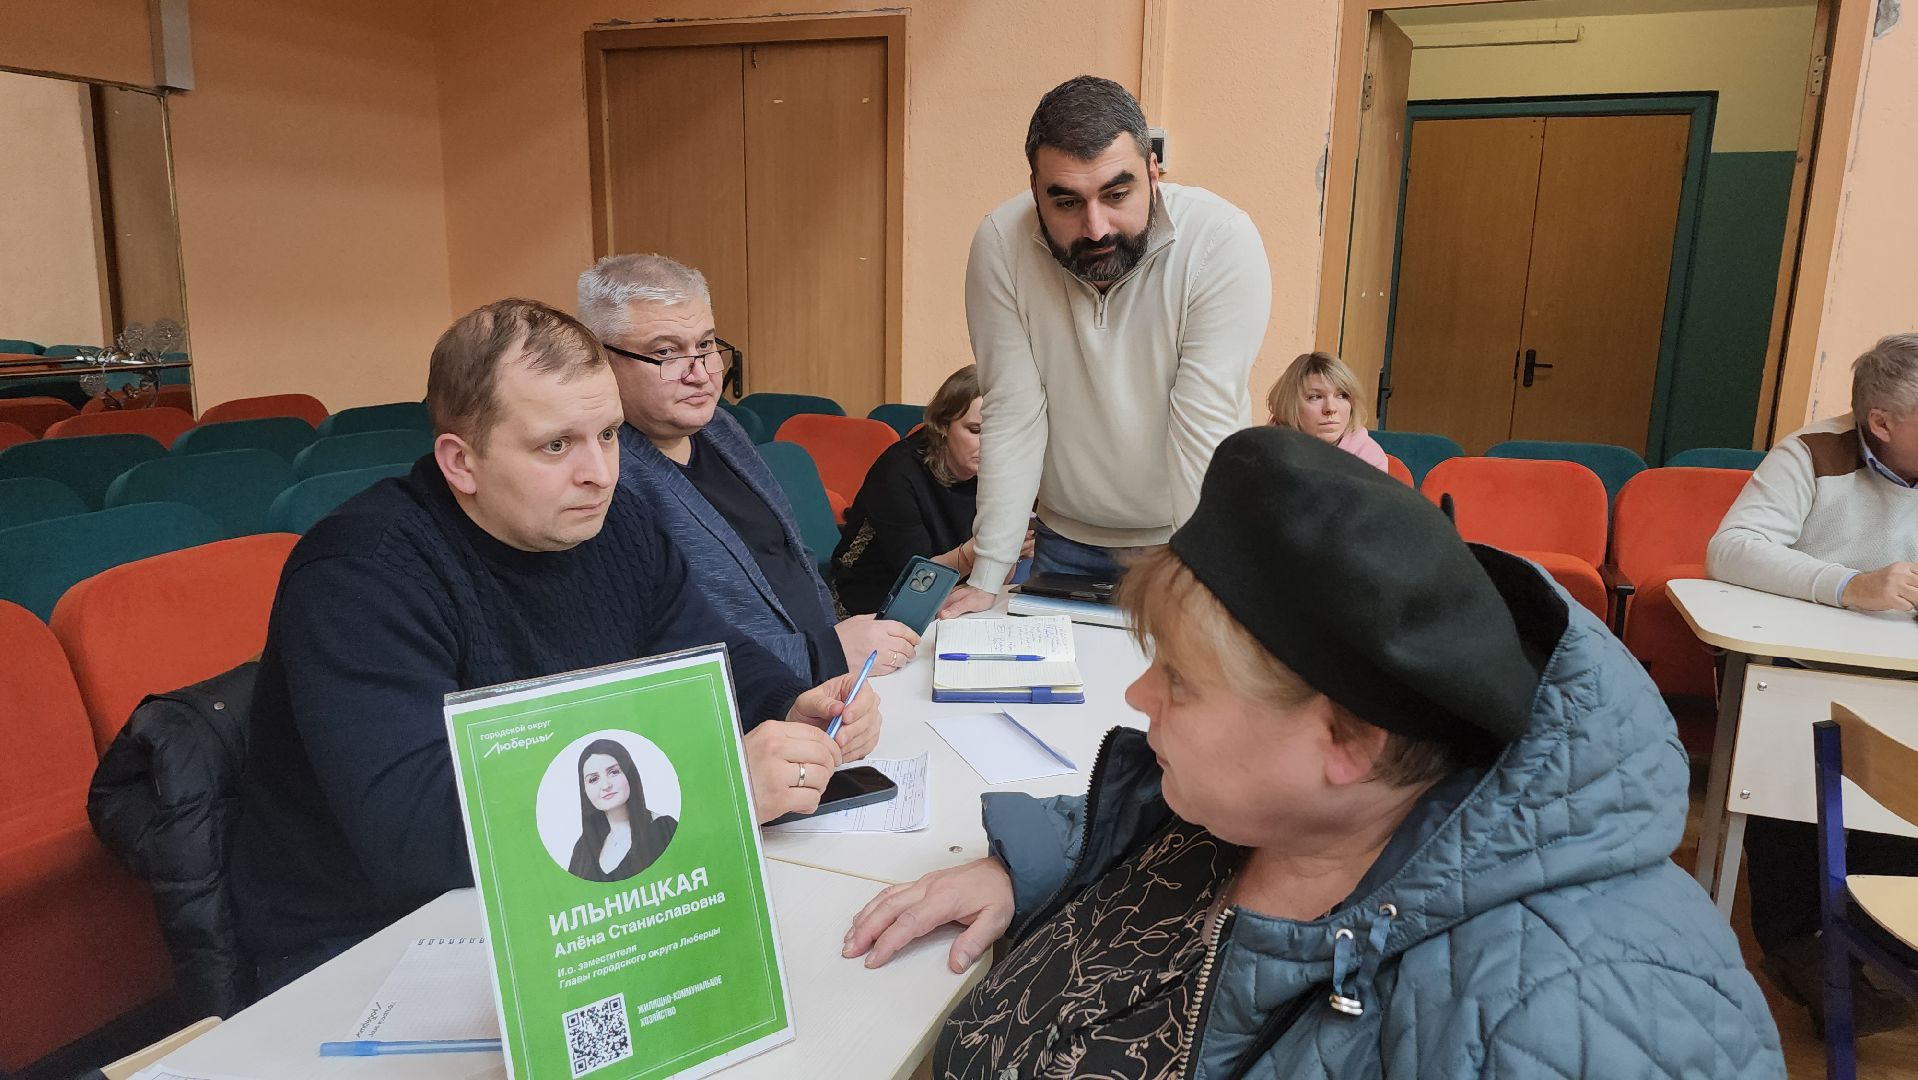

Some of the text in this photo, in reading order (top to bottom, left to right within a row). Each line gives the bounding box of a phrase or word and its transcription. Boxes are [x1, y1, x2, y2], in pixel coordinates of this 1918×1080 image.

[480, 719, 552, 740] городской округ
[483, 732, 554, 758] Люберцы
[549, 866, 709, 936] ИЛЬНИЦКАЯ
[554, 891, 726, 958] Алёна Станиславовна
[557, 945, 637, 978] И.о. заместителя
[559, 927, 721, 989] Главы городского округа Люберцы
[637, 975, 723, 1014] ЖИЛИЩНО-КОММУНАЛЬНОЕ
[640, 1007, 677, 1028] ХОЗЯЙСТВО
